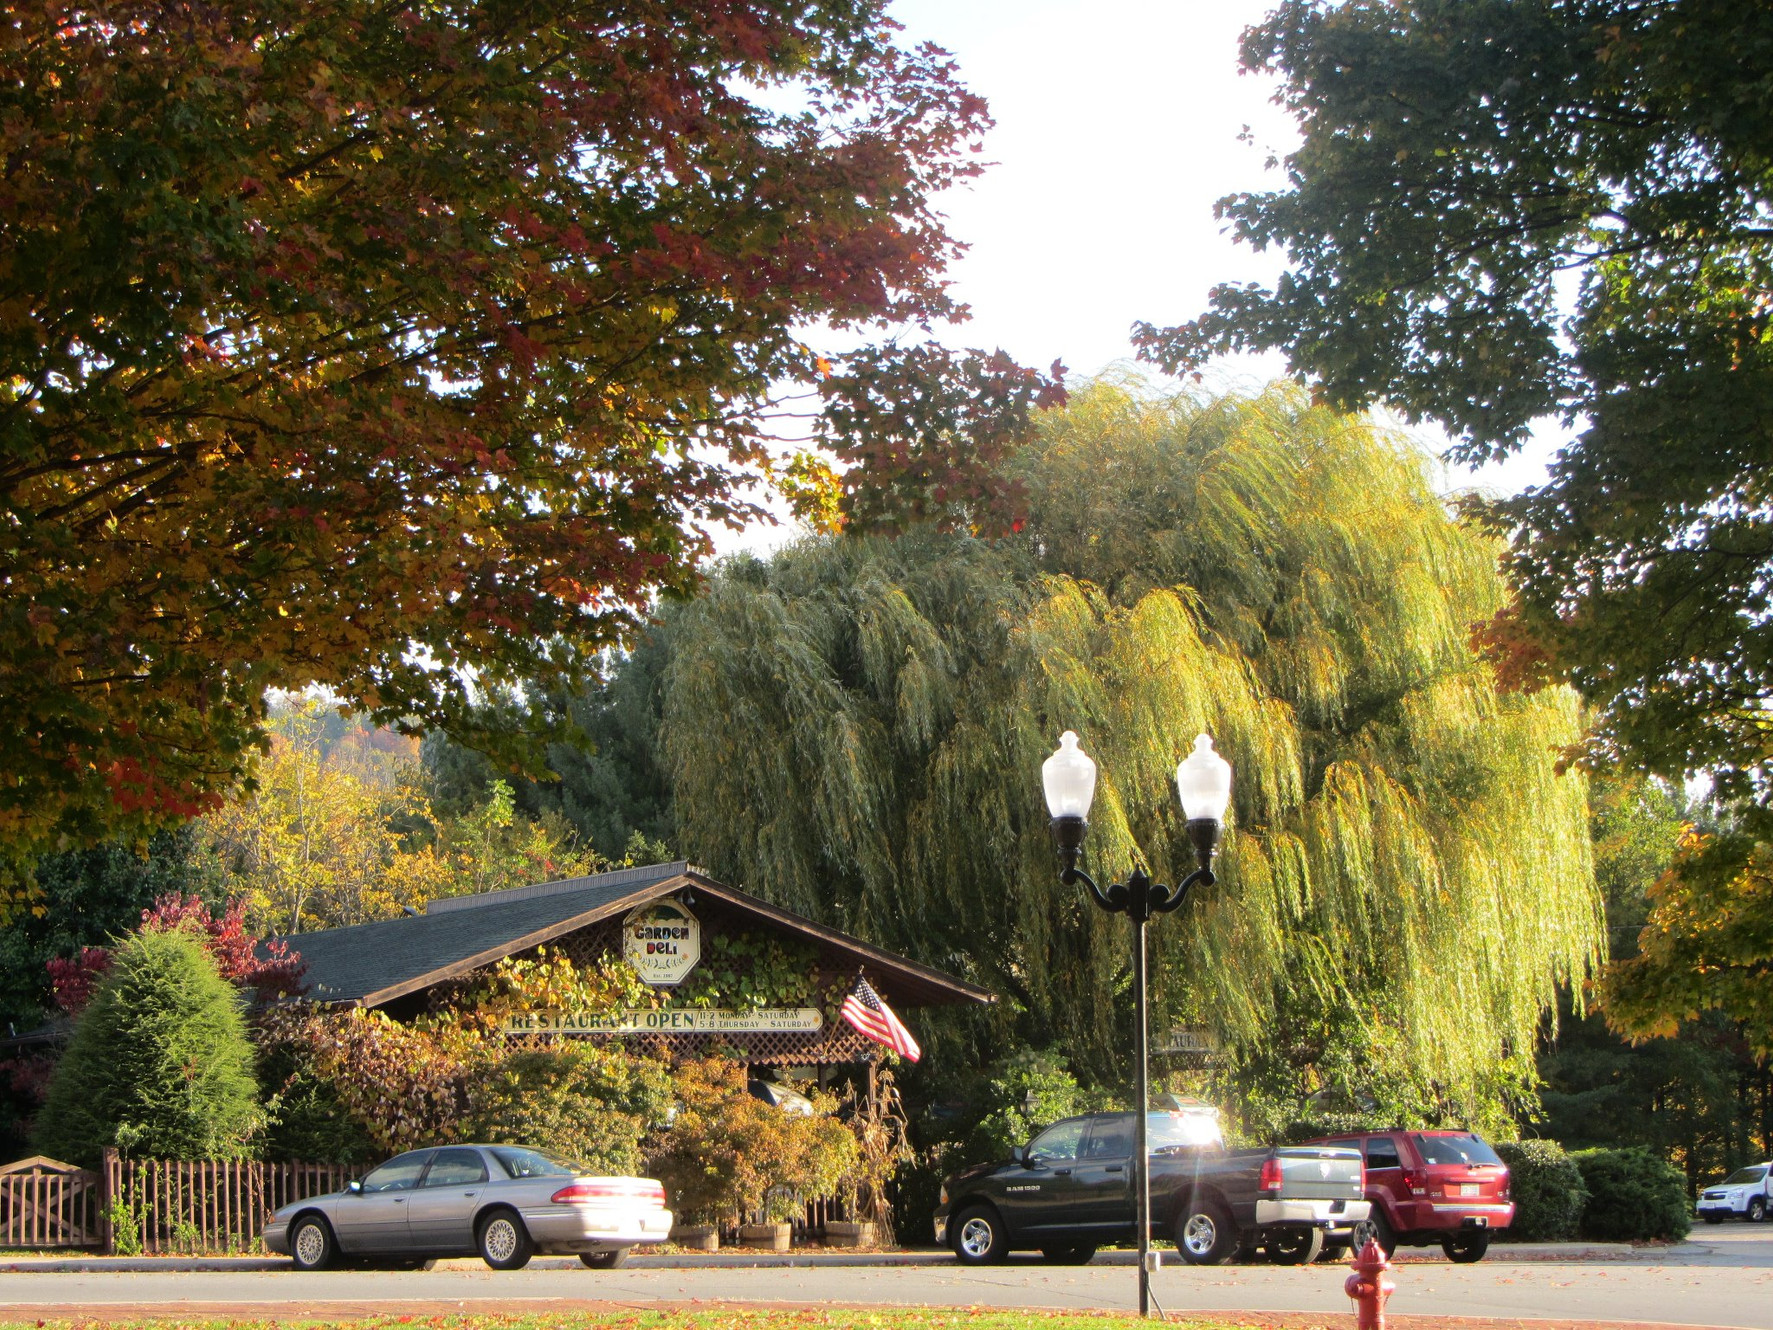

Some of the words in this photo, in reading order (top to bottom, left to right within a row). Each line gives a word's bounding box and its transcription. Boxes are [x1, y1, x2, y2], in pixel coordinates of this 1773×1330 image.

[646, 1012, 694, 1028] OPEN
[718, 1011, 751, 1020] MONDAY
[757, 1011, 800, 1020] SATURDAY
[718, 1020, 760, 1028] THURSDAY
[770, 1020, 812, 1028] SATURDAY
